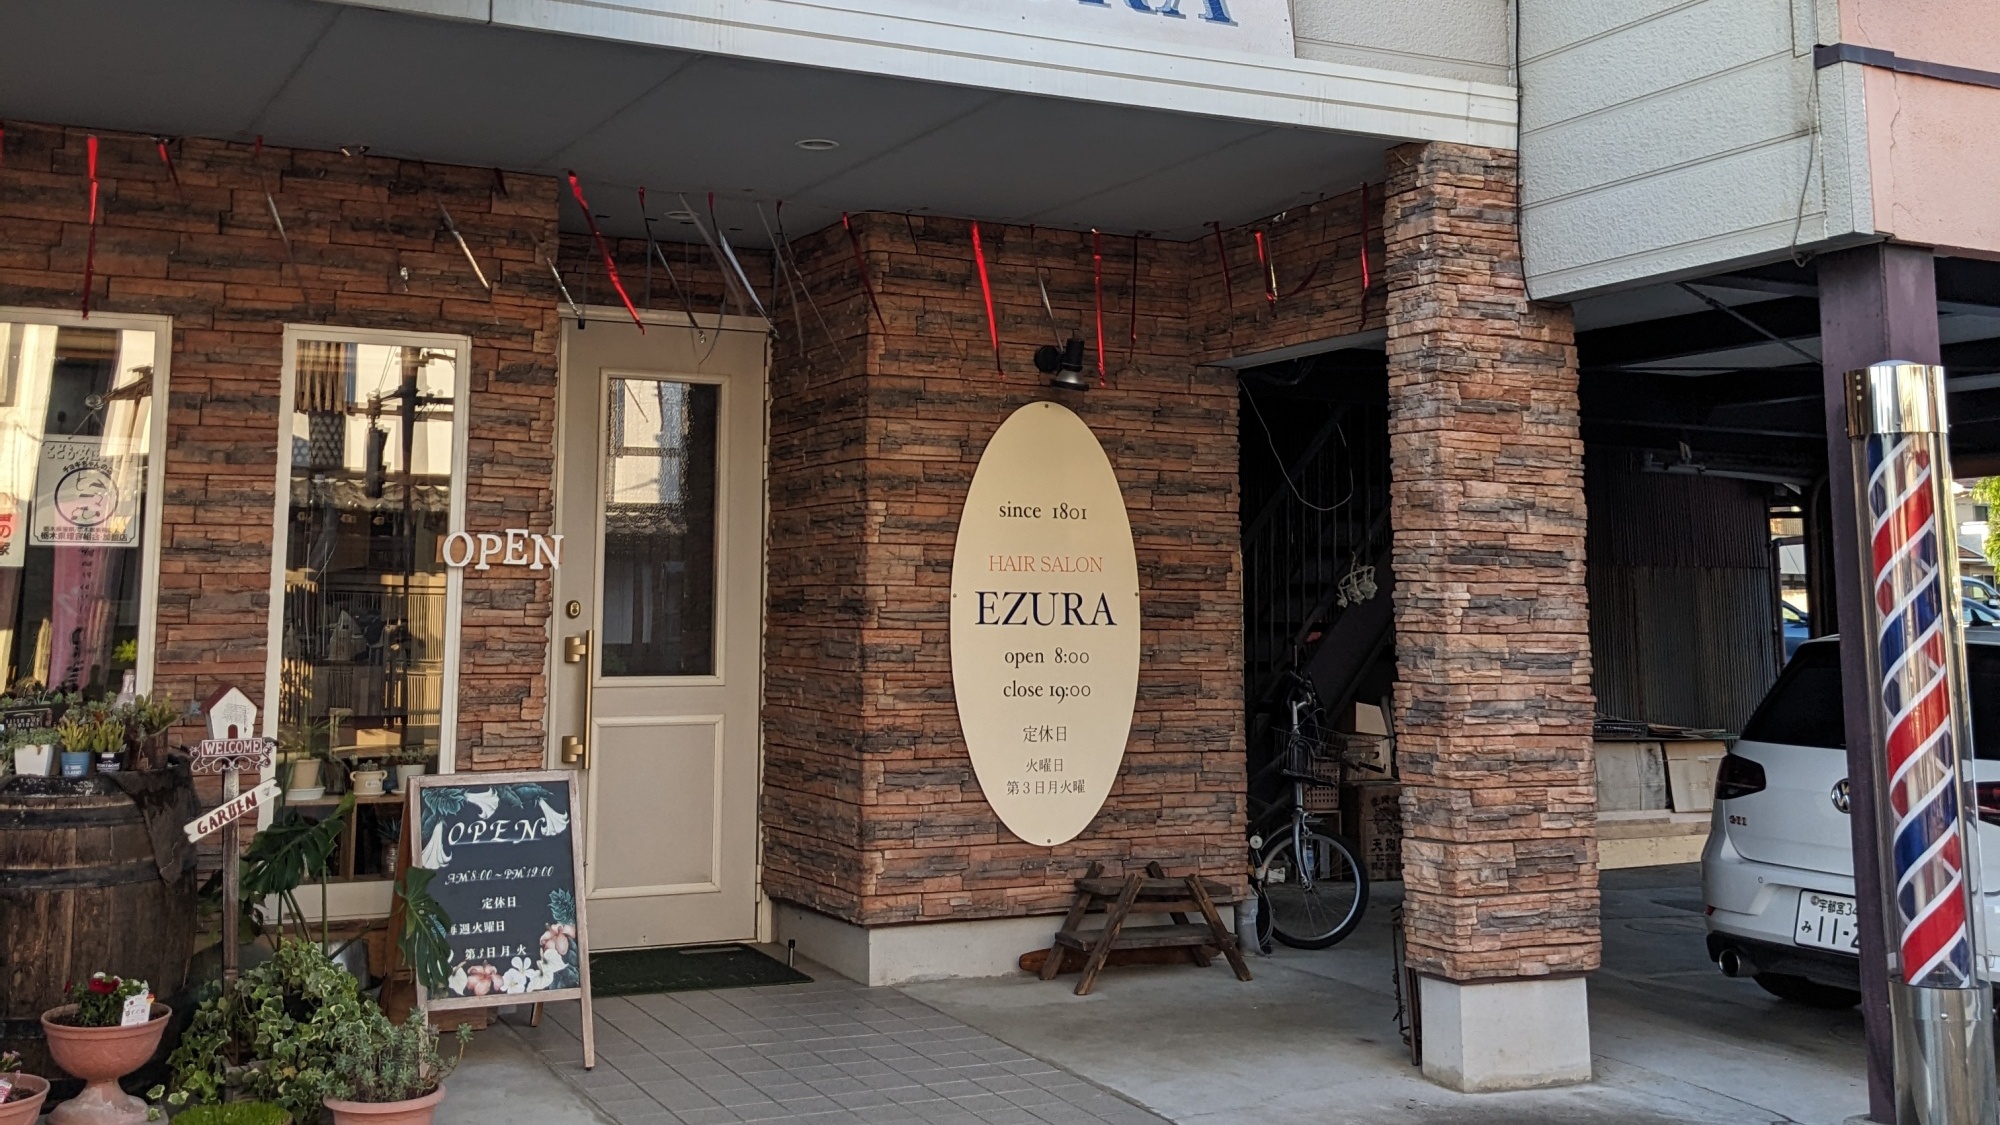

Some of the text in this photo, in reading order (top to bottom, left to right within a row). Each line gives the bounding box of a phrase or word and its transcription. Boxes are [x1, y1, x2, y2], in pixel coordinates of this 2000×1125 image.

[999, 501, 1087, 519] since 1801
[442, 528, 564, 570] OPEN
[989, 555, 1103, 573] HAIR SALON
[975, 591, 1117, 626] EZURA
[1004, 647, 1089, 668] open 8:00
[1003, 680, 1091, 704] close 19:00
[1023, 725, 1067, 742] 定休日
[204, 740, 260, 755] WELCOME
[1026, 758, 1063, 772] 火曜日
[197, 791, 257, 834] GARDEN
[448, 818, 545, 845] OPEN
[481, 896, 516, 909] 定休日
[1801, 921, 1812, 933] み
